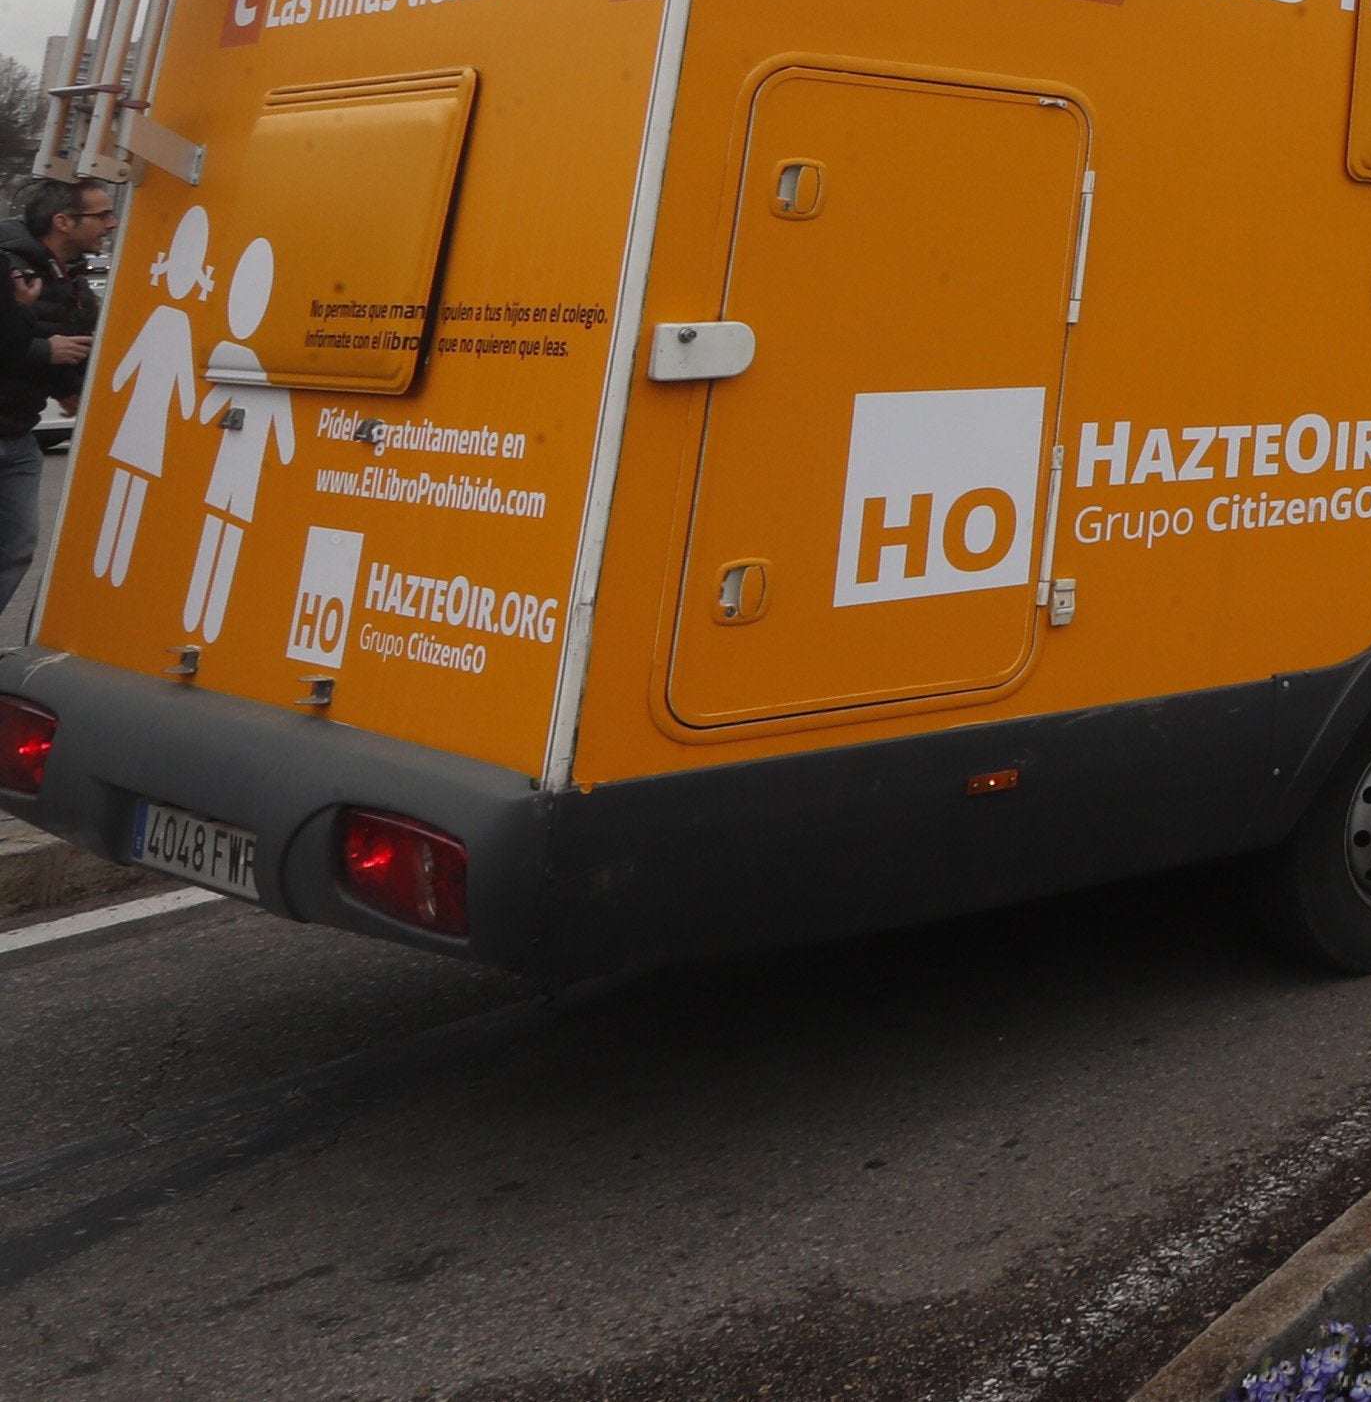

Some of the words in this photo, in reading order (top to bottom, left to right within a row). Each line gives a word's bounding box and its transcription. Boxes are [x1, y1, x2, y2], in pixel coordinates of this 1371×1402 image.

[310, 299, 324, 317] No
[324, 300, 367, 322] permitas
[368, 303, 388, 322] que
[475, 306, 482, 321] a
[484, 303, 502, 322] tus
[504, 302, 530, 326] hijos
[533, 306, 546, 322] en
[549, 302, 562, 322] el
[562, 302, 608, 329] colegio.
[305, 329, 351, 348] Infórmate
[352, 335, 370, 349] con
[371, 331, 382, 349] el
[438, 336, 458, 357] que
[460, 338, 474, 353] no
[475, 335, 516, 358] quieren
[519, 340, 540, 360] que
[542, 336, 569, 356] leas.
[317, 407, 362, 443] Pídel
[372, 422, 499, 460] gratuitamente
[502, 432, 526, 459] en
[316, 465, 547, 519] www.ElLibroProhibido.com
[855, 486, 1018, 585] HO
[1074, 506, 1195, 549] Grupo
[294, 591, 346, 654] HO
[360, 623, 403, 662] Grupo
[408, 632, 486, 674] CitizenGO
[148, 810, 206, 873] 4048
